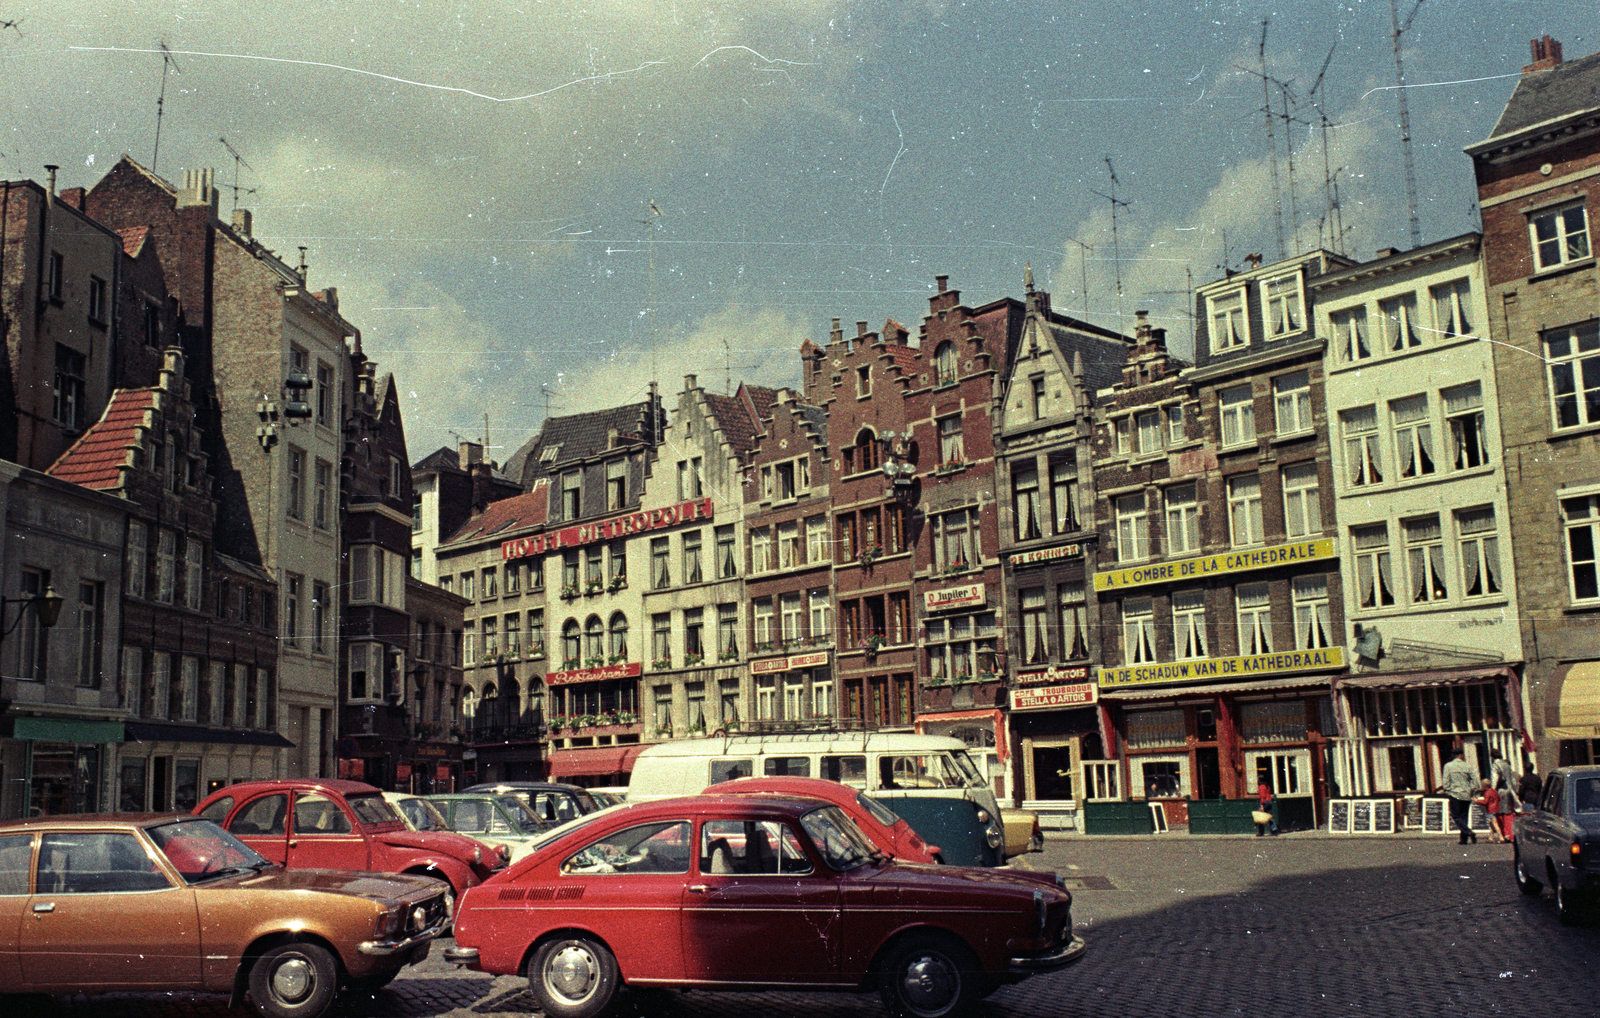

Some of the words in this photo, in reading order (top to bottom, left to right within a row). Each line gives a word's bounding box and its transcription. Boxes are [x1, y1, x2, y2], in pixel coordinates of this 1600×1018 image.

[506, 531, 568, 558] HOTEL
[579, 501, 707, 544] METROPOLE
[1009, 554, 1024, 565] DE
[1028, 544, 1077, 561] KONINCK
[1106, 574, 1114, 586] A
[1181, 562, 1195, 575] DE
[1202, 558, 1218, 572] LA
[1227, 544, 1316, 569] CATHEDRALE
[937, 588, 969, 602] Jupiler
[553, 667, 631, 684] Restaurant
[1104, 671, 1114, 683] IN
[1118, 670, 1132, 682] DE
[1135, 663, 1189, 681] SCHADUW
[1193, 660, 1218, 676] VAN
[1222, 659, 1237, 673] DE
[1243, 651, 1332, 671] KATHEDRAAL
[1017, 672, 1050, 684] STELLA
[1054, 668, 1086, 680] ARTOIS
[1042, 684, 1092, 695] TROUBADOUR
[1022, 696, 1049, 706] STELLA
[1057, 693, 1086, 703] ARTOIS
